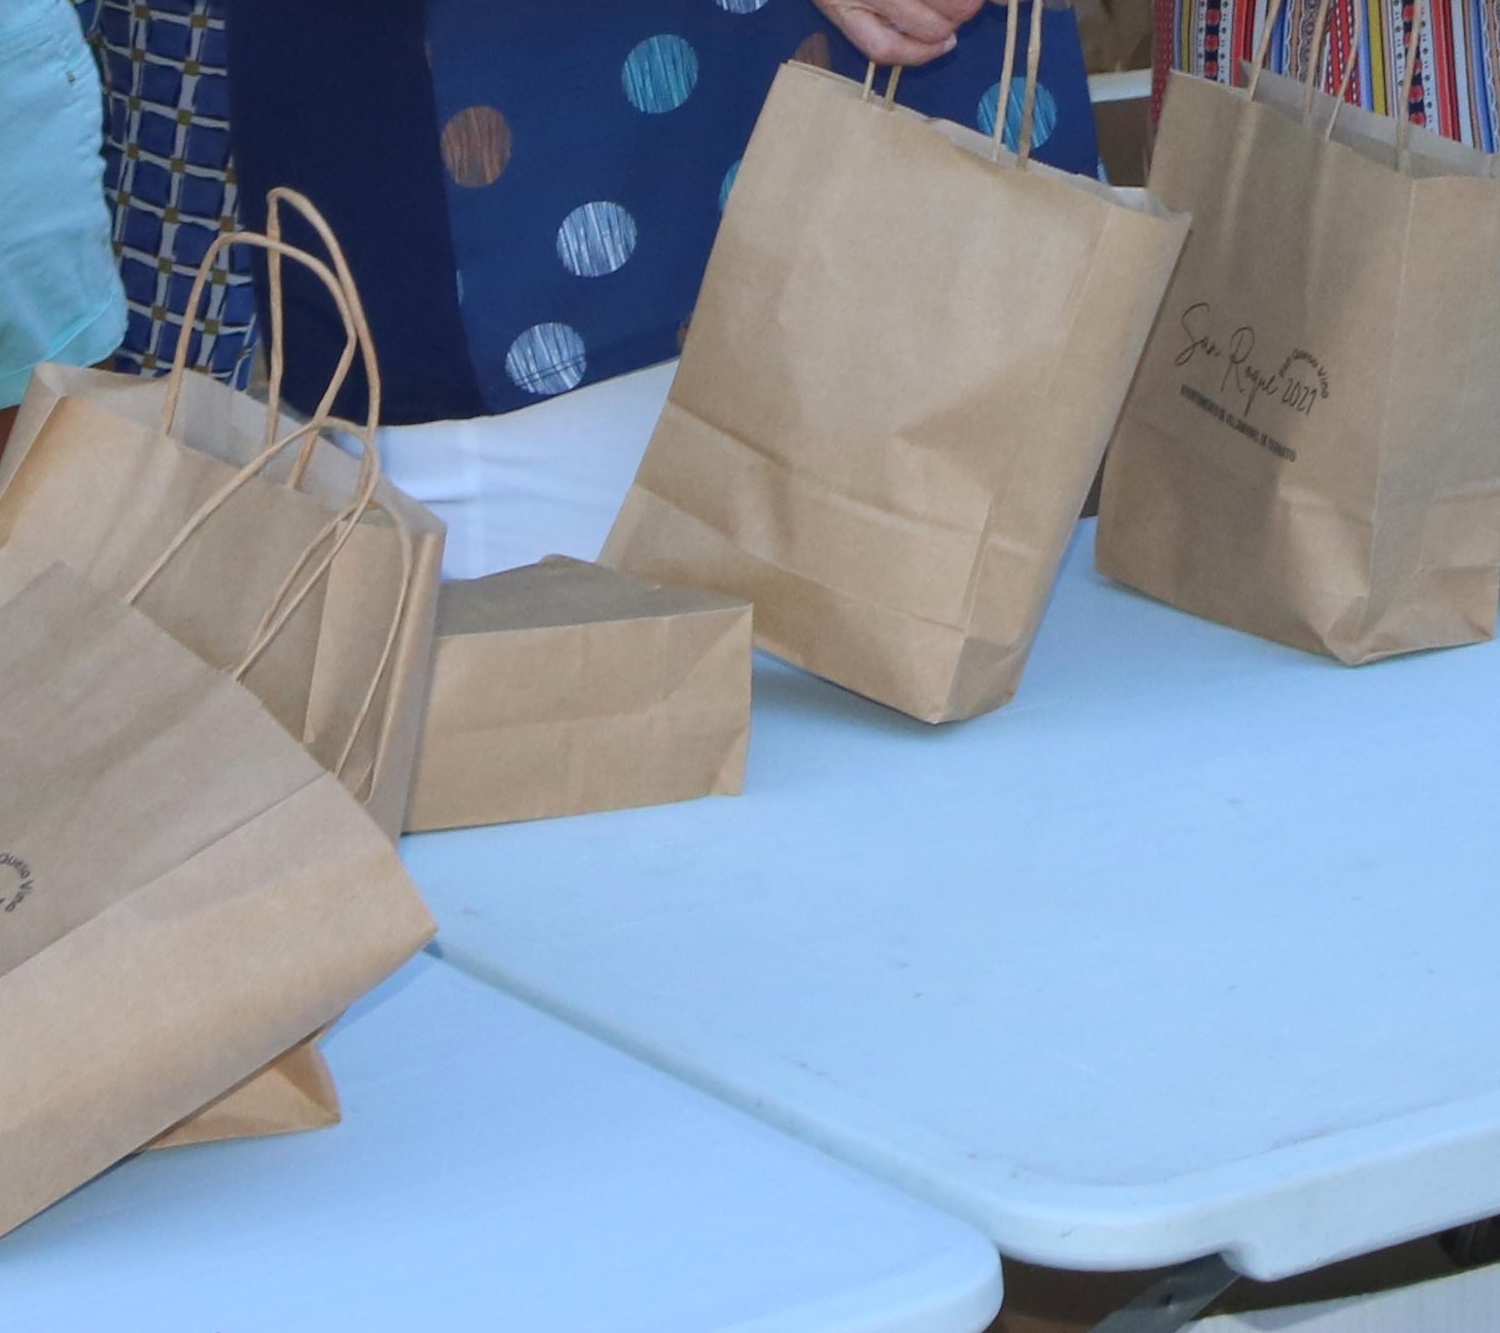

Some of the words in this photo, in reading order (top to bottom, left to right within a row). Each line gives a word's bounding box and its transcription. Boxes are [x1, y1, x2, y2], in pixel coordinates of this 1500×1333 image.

[1174, 301, 1221, 367] San
[1220, 326, 1277, 417] Roque
[1281, 377, 1318, 416] 2021
